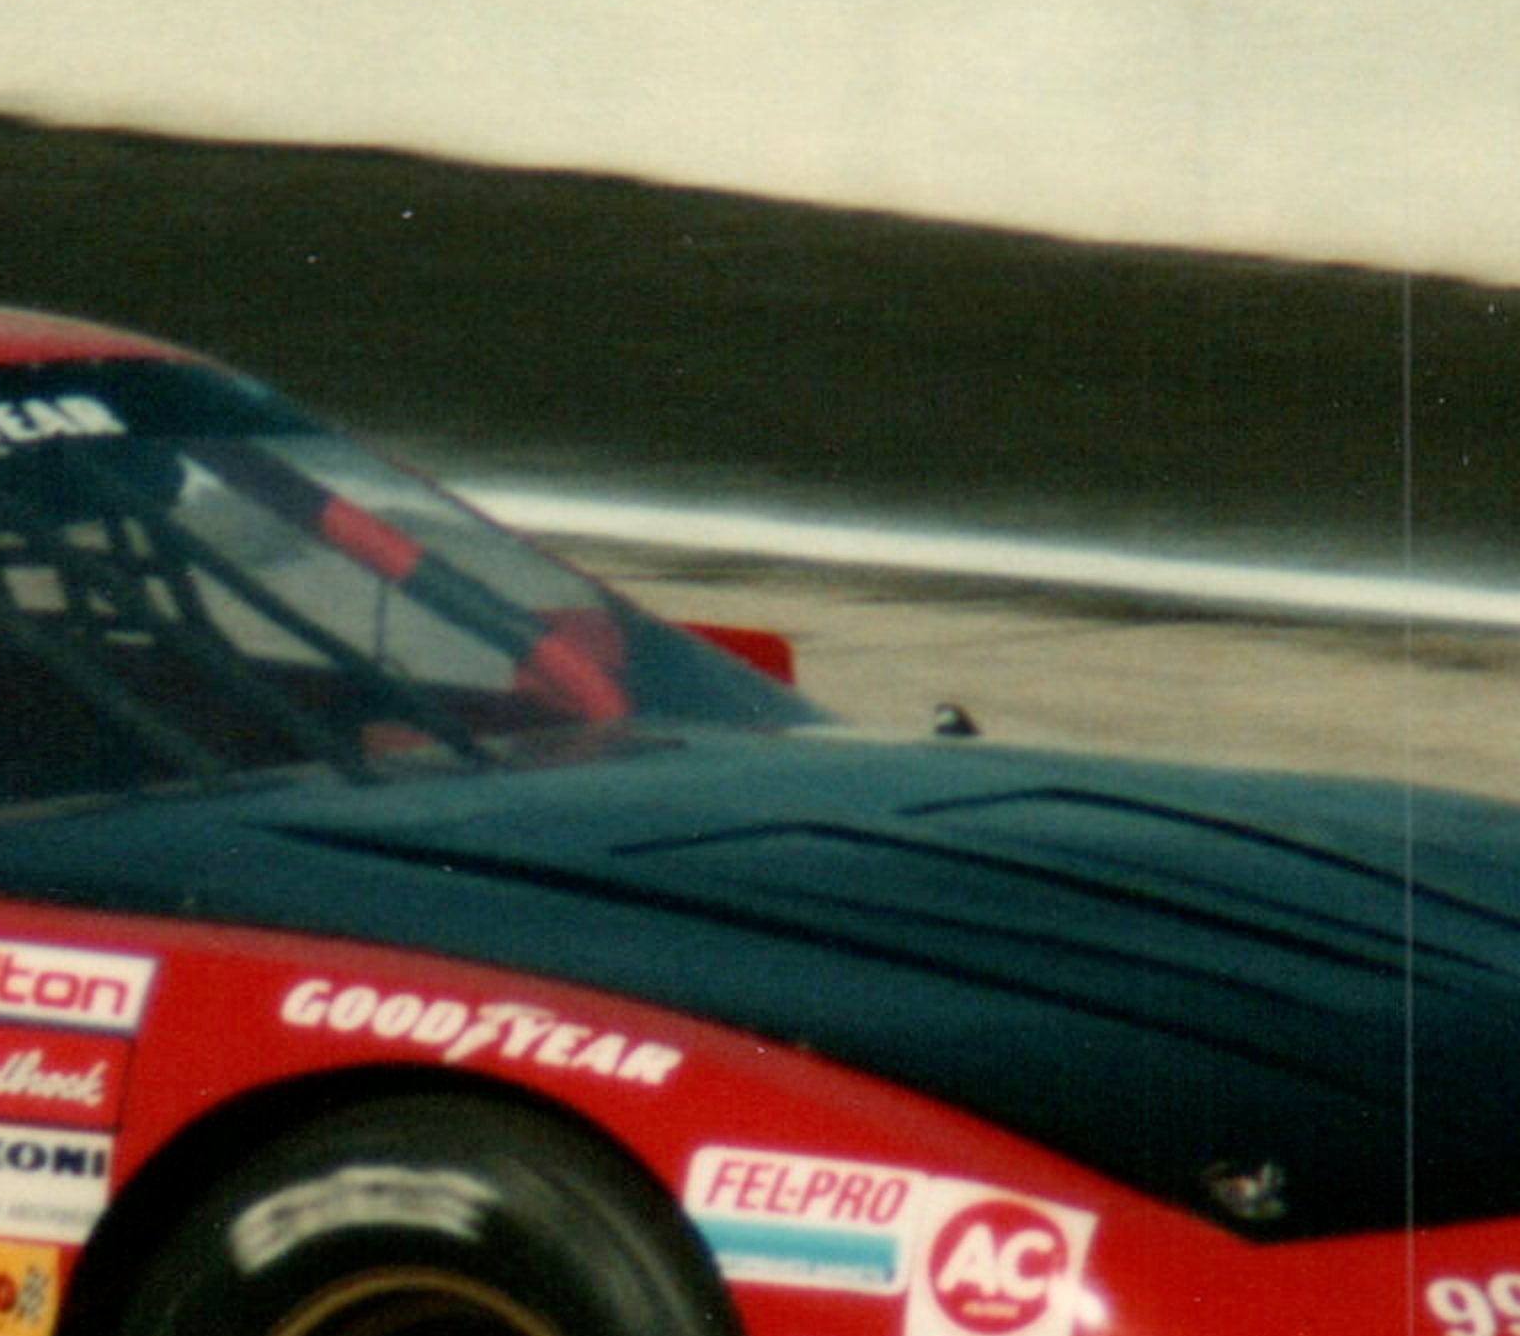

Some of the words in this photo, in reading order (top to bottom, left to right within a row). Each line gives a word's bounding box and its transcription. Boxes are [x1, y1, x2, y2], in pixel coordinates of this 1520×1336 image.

[280, 978, 684, 1086] GOODYEAR
[704, 1159, 911, 1225] FEL-PRO
[937, 1223, 1056, 1301] AC
